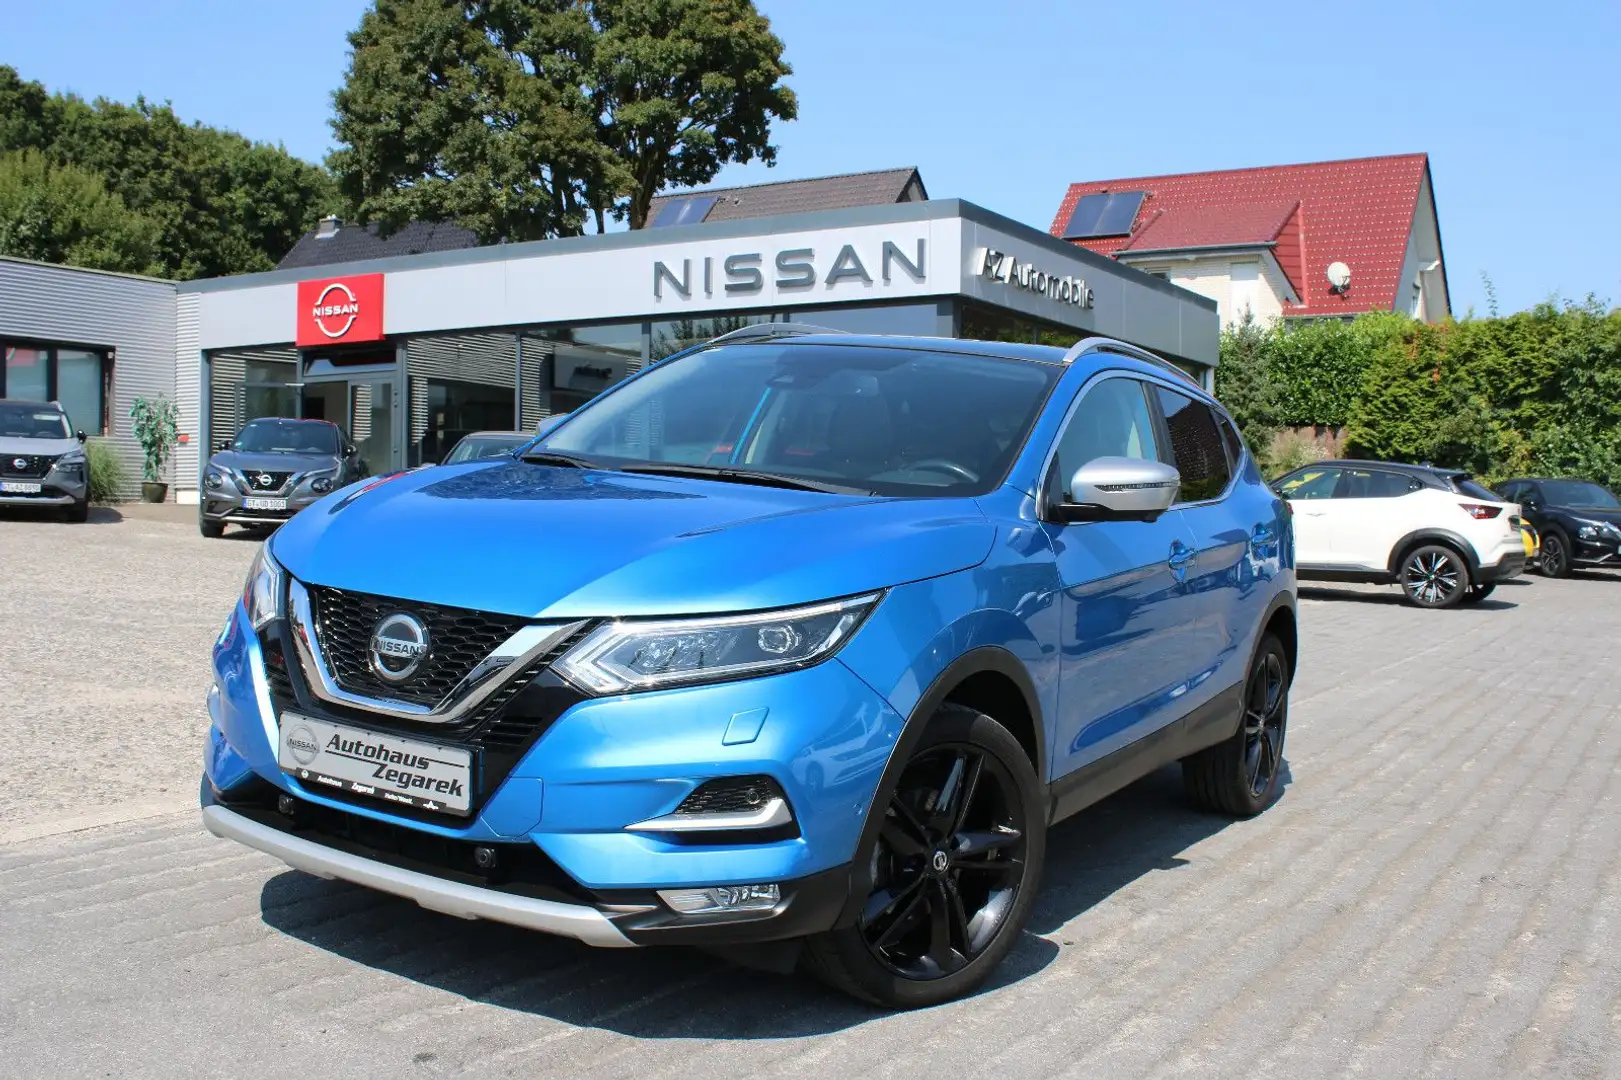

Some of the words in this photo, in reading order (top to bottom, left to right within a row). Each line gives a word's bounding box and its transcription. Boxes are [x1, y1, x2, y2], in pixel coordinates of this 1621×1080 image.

[654, 238, 926, 298] NISSAN
[1003, 256, 1094, 309] Automobile
[312, 304, 358, 317] NISSAN
[376, 639, 420, 656] NISSAN
[289, 738, 317, 751] NISSAN
[326, 733, 430, 769] Autohaus
[372, 763, 465, 797] Zegarek
